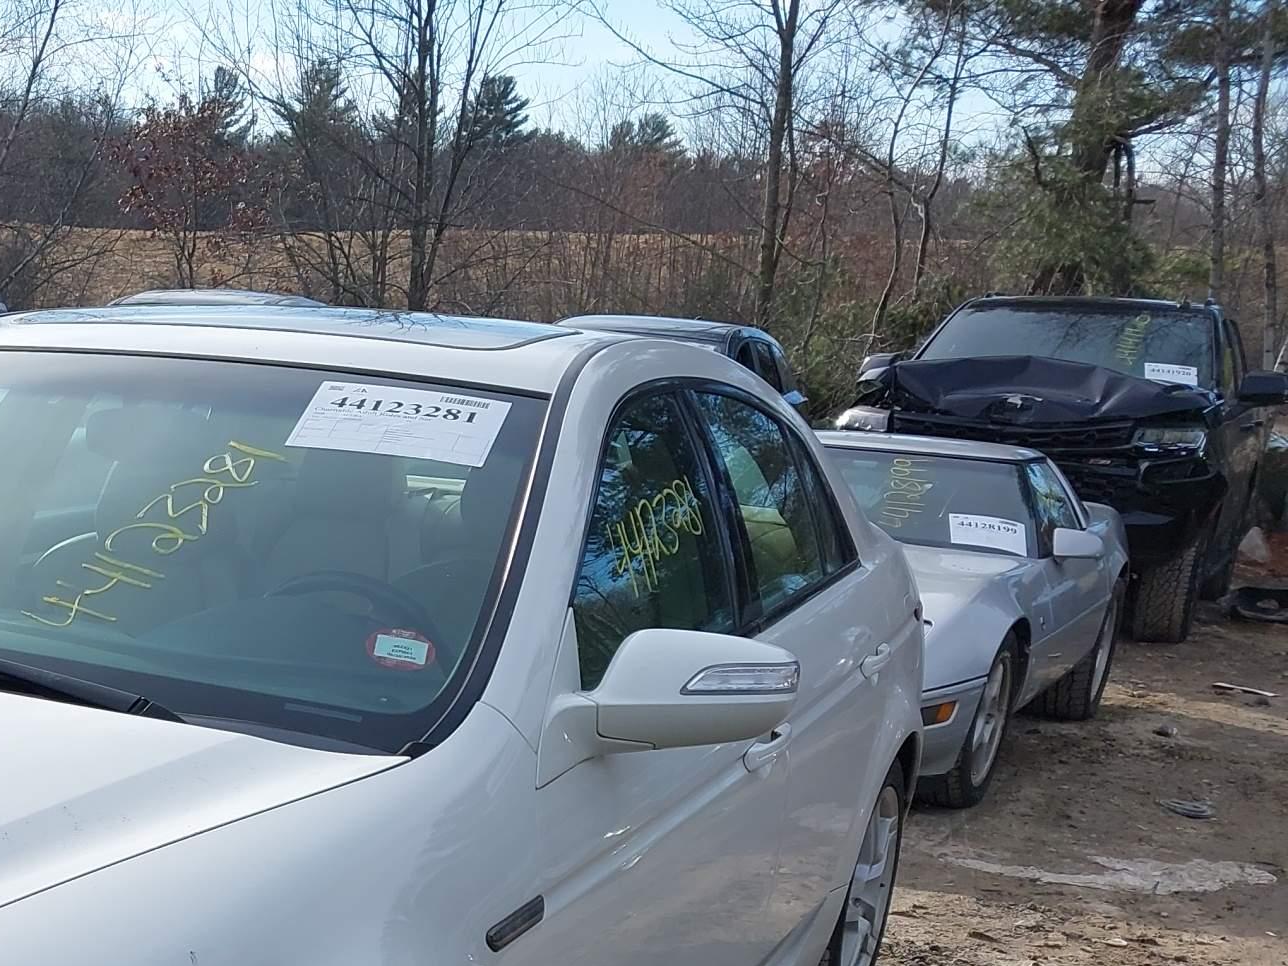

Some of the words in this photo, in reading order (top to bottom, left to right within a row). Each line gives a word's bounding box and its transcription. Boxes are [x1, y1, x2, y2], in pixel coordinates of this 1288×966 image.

[329, 396, 478, 424] 44123281
[20, 440, 289, 627] 44123281
[957, 520, 1017, 535] 44128199
